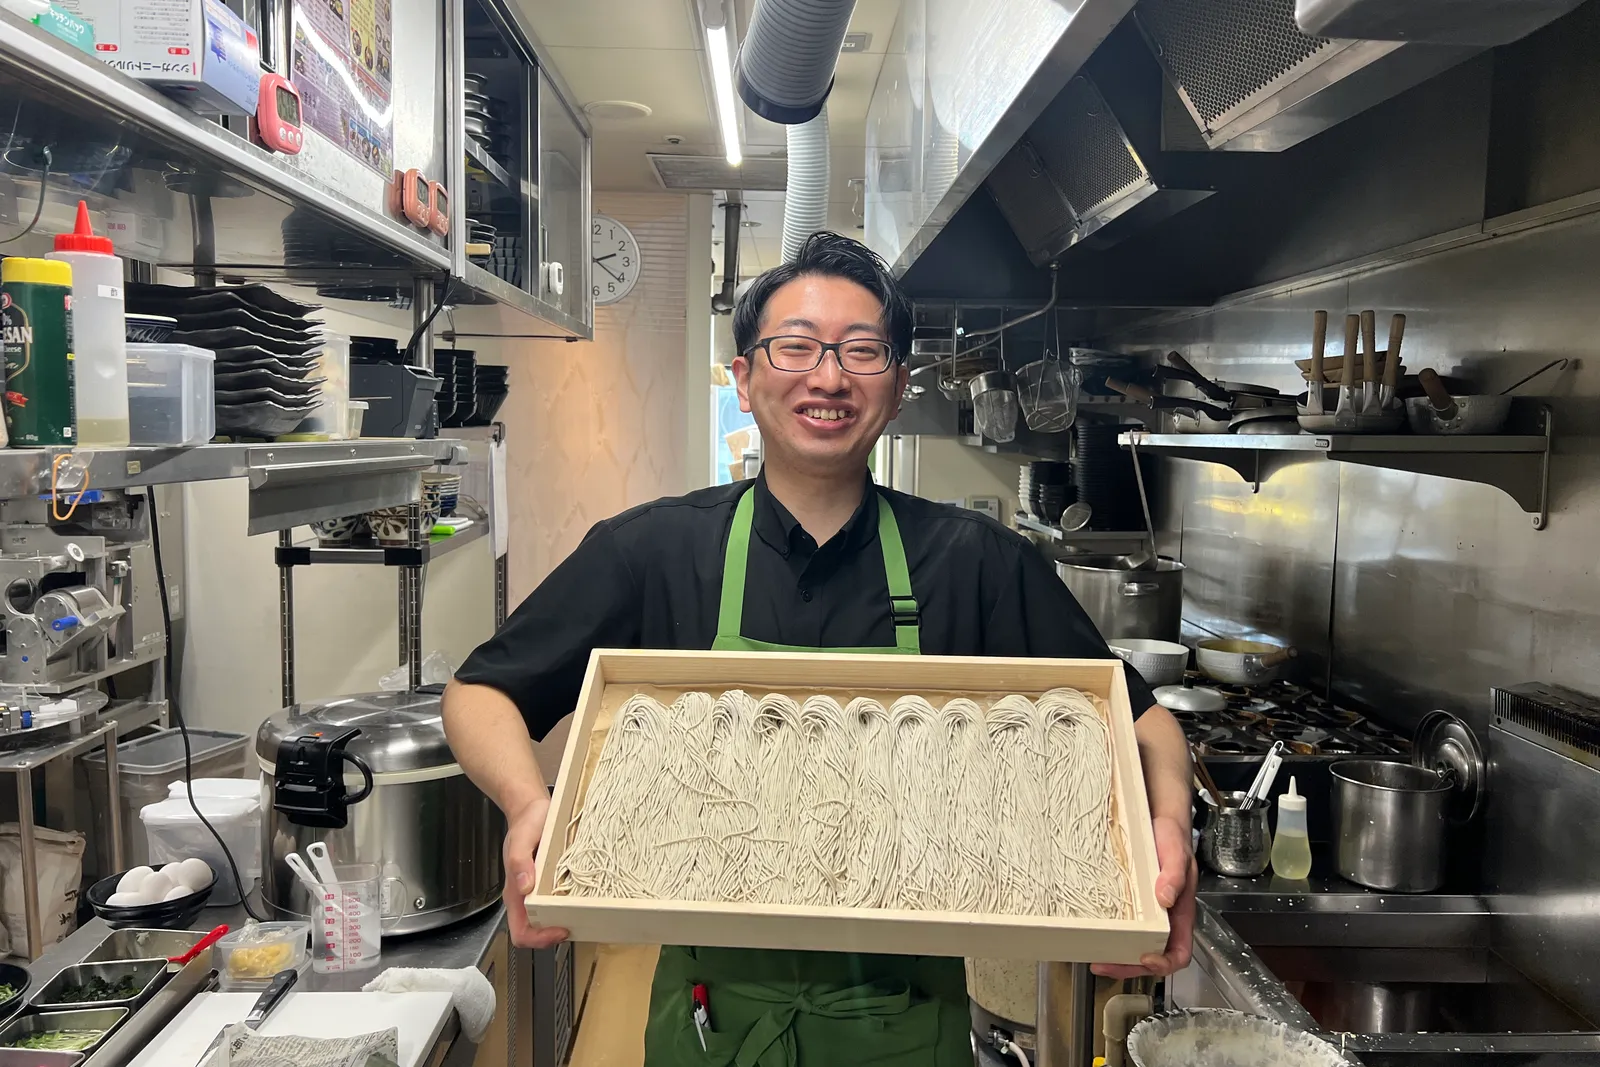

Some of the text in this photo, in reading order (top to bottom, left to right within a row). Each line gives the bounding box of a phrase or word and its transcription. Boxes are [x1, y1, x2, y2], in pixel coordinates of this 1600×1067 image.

[610, 229, 613, 240] 1
[618, 240, 626, 251] 2
[622, 256, 630, 267] 3
[593, 285, 600, 296] 6
[608, 282, 615, 293] 5
